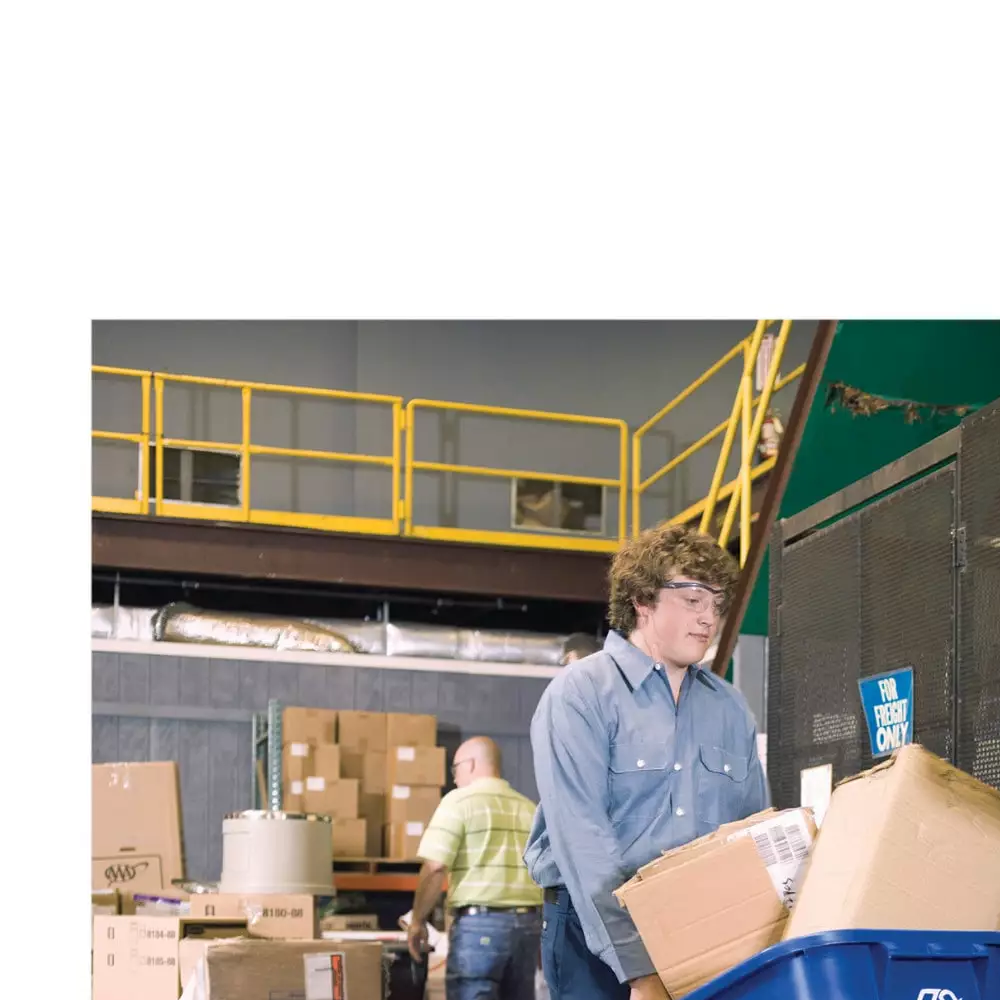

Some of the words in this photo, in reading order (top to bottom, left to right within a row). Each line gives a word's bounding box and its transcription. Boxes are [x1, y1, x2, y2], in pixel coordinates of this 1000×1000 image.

[878, 678, 898, 702] FOR
[874, 699, 908, 727] FREIGHT
[876, 722, 909, 751] ONLY
